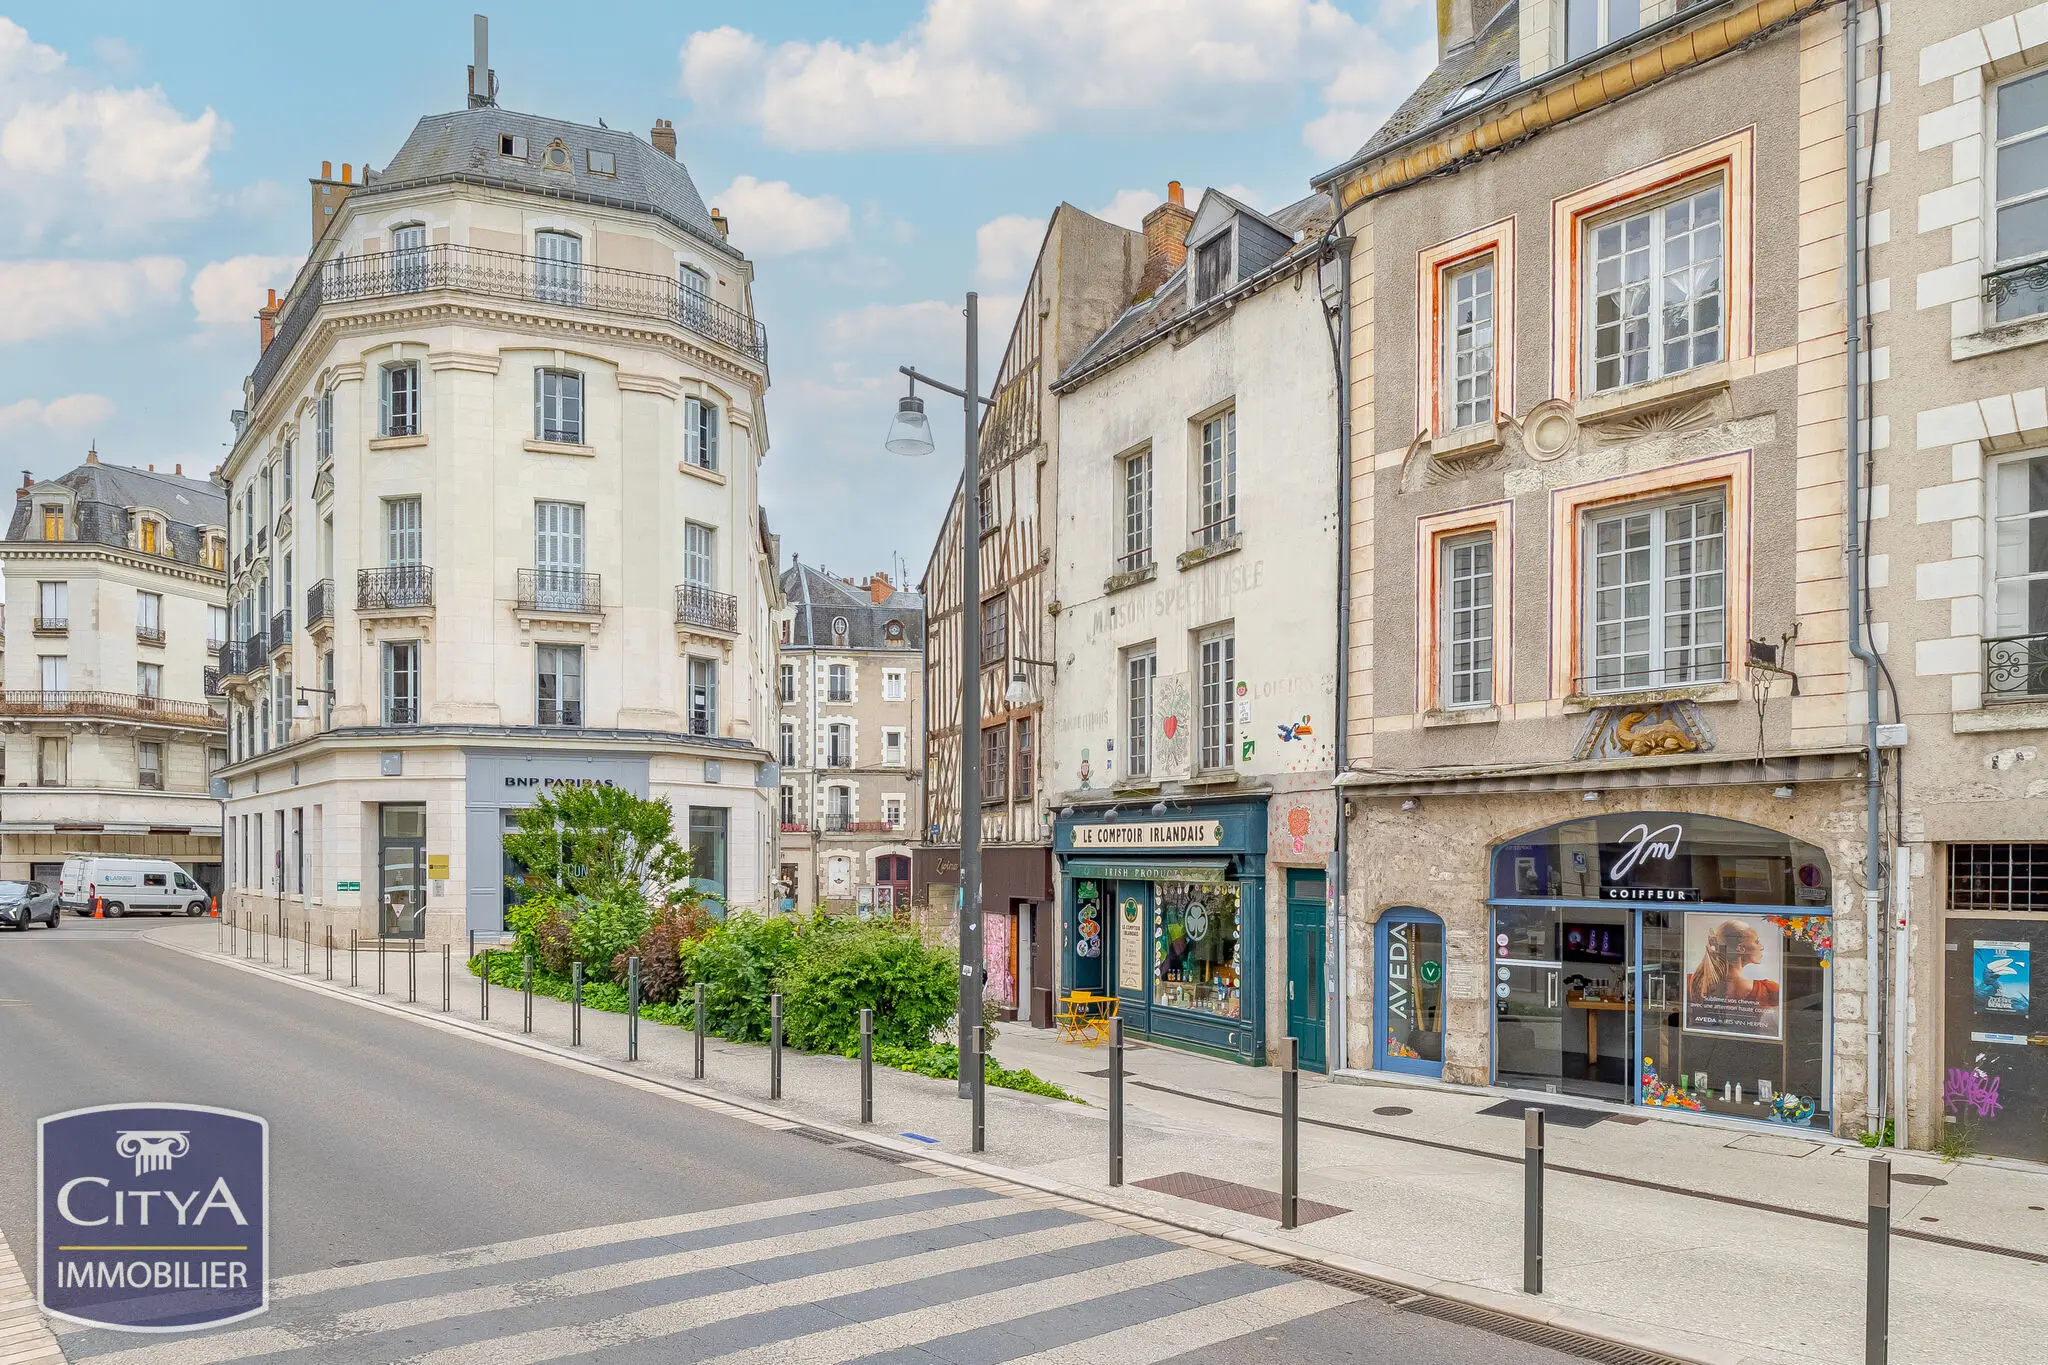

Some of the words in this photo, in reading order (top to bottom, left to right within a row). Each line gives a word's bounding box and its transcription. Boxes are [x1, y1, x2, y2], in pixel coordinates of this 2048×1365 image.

[505, 777, 540, 787] BNP
[1083, 829, 1092, 843] LE
[1098, 828, 1143, 843] COMPTOIR
[1150, 825, 1204, 842] IRLANDAIS
[1104, 868, 1128, 878] IRISH
[1609, 889, 1686, 900] COIFFEUR
[1389, 922, 1408, 1020] AVEDA
